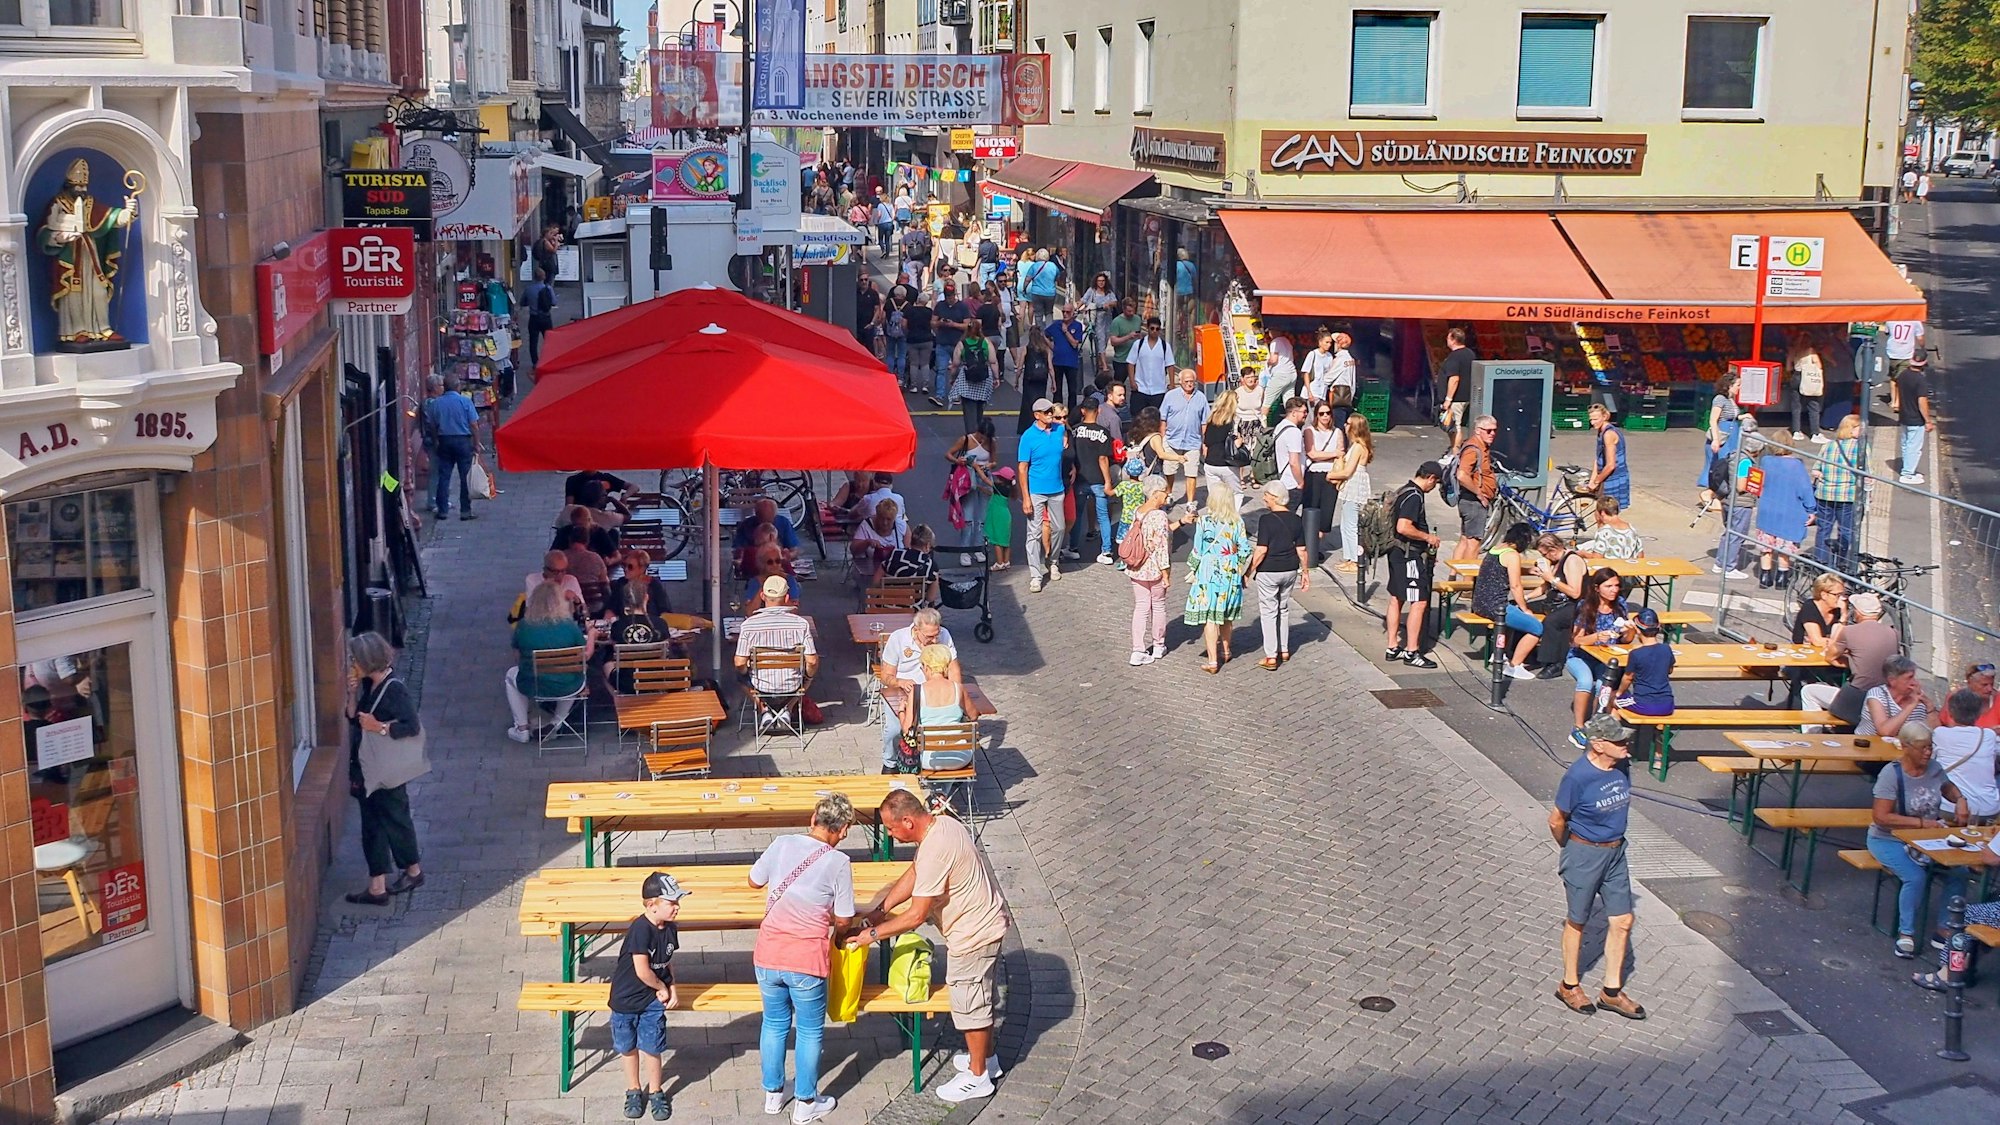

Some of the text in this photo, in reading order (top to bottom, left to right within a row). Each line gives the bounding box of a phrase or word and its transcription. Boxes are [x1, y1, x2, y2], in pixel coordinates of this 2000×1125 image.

[904, 64, 986, 88] DESCH
[831, 90, 987, 109] SEVERINSTRASSE
[770, 110, 784, 120] 3.
[786, 110, 879, 121] Wochenende
[883, 111, 900, 120] im
[905, 110, 981, 122] September
[975, 138, 1016, 148] KIOSK
[988, 148, 1004, 157] 46
[1270, 131, 1364, 171] CAN
[1371, 139, 1529, 163] SÜDLÄNDISCHE
[345, 174, 427, 187] TURISTA
[366, 187, 405, 203] SÜD
[364, 206, 410, 216] Tapas-Bar
[803, 234, 858, 242] Backfisch
[342, 246, 404, 272] DER
[1737, 245, 1752, 267] E
[343, 275, 404, 288] Touristik
[347, 301, 398, 313] Partner
[1506, 306, 1711, 320] CAN Südländische Feinkost
[1894, 324, 1911, 340] 07
[1495, 368, 1544, 377] Chlodwigplatz
[19, 412, 194, 460] A.D. 1895.
[1596, 792, 1630, 808] AUSTRAL
[104, 874, 140, 900] DER
